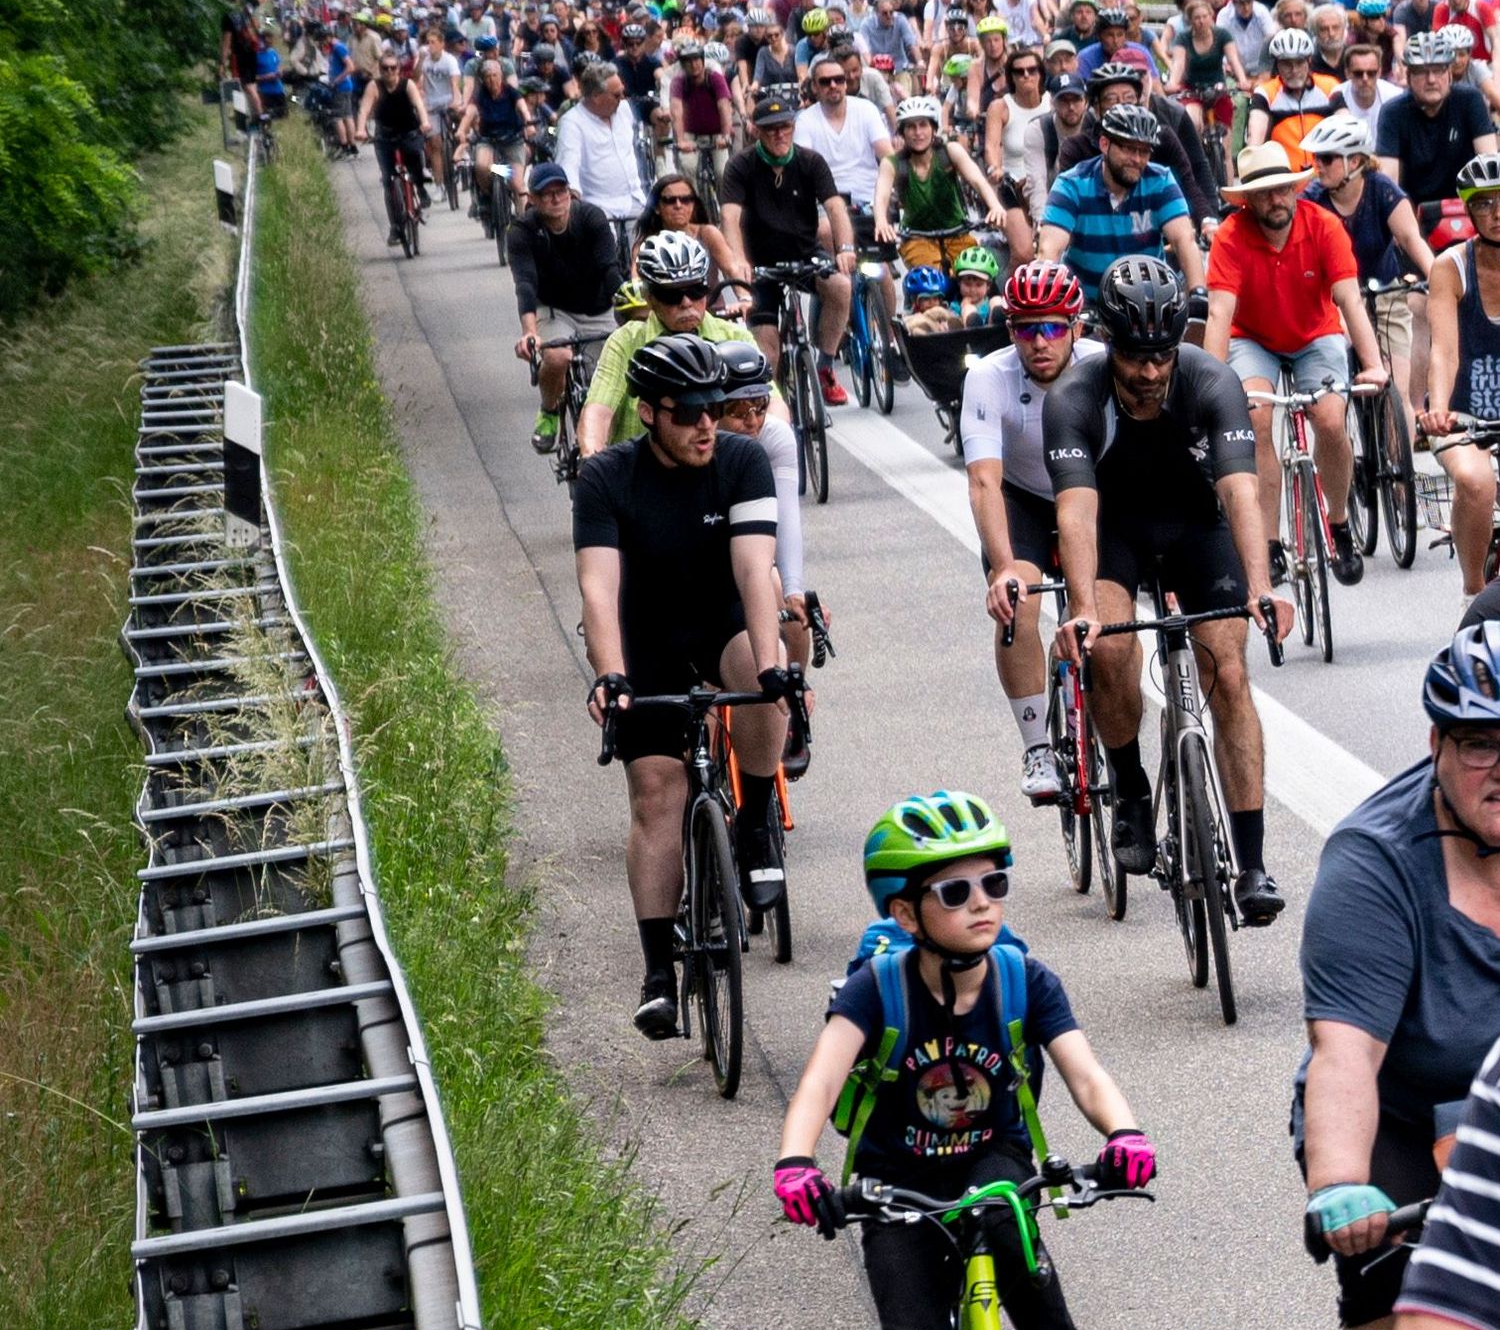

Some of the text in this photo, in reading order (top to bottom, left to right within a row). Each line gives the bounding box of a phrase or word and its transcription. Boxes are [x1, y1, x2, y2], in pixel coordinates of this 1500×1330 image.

[1049, 448, 1087, 461] T.K.O.
[1177, 663, 1194, 713] BMC
[906, 1035, 1001, 1077] PAW PATROL
[905, 1125, 993, 1148] SUMMER
